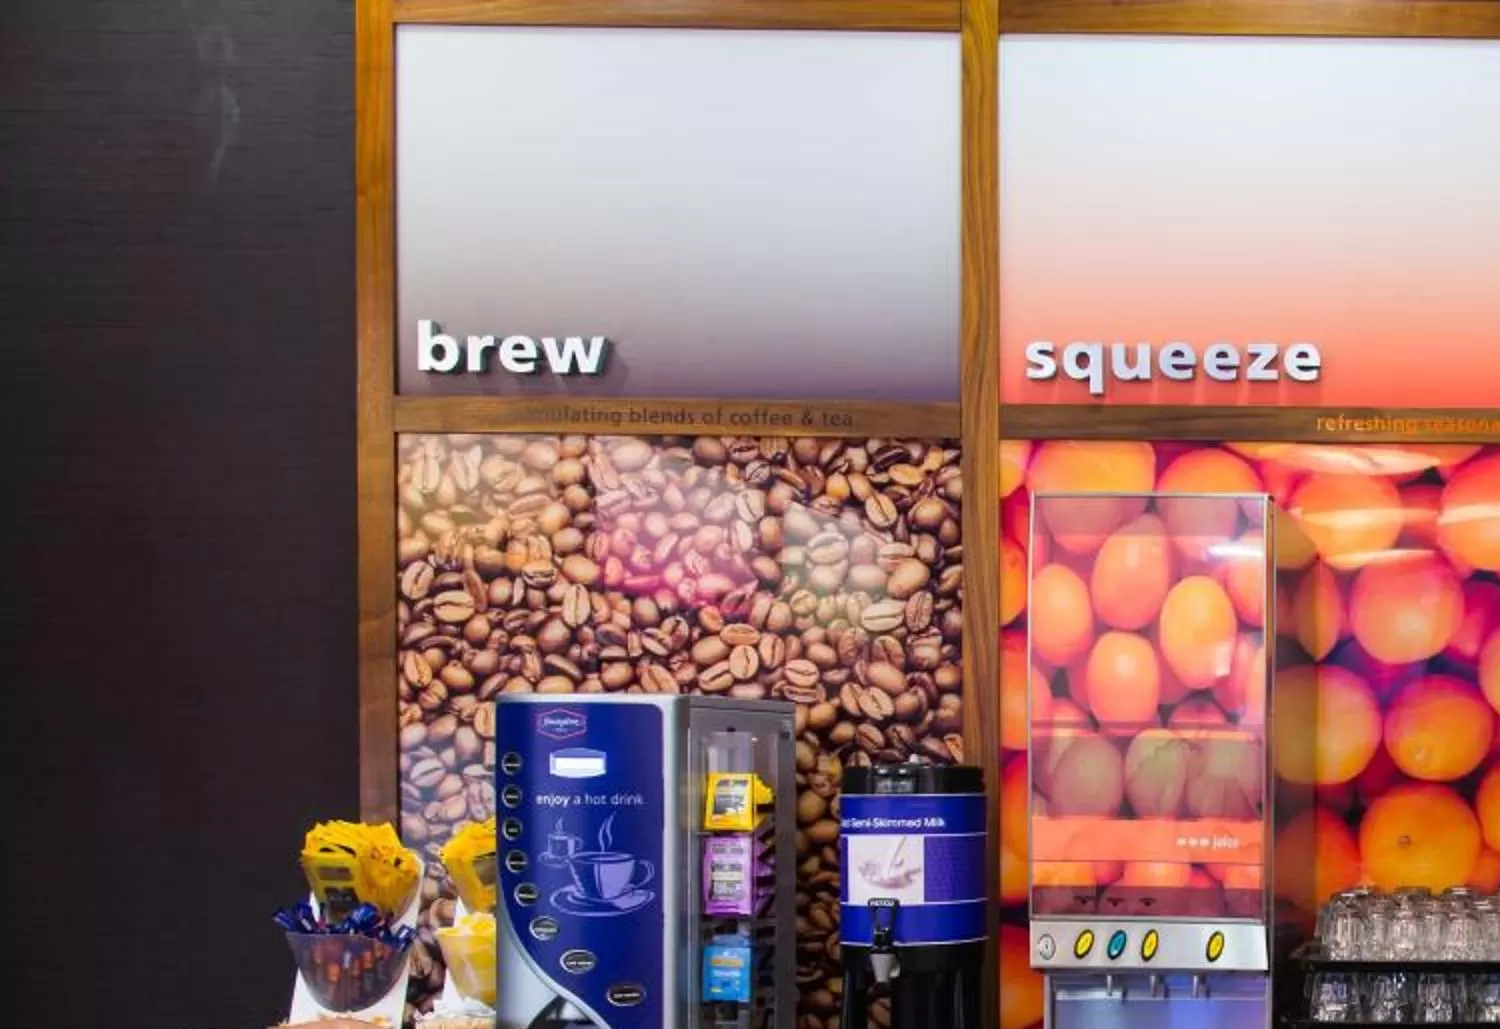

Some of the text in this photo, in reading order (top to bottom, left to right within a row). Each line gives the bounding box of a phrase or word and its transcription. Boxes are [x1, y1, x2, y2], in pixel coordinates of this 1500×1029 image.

[416, 319, 606, 375] brew
[1024, 340, 1322, 396] squeeze
[629, 406, 695, 425] blends
[702, 406, 722, 425] of
[730, 407, 793, 426] coffee
[801, 408, 815, 426] &
[821, 409, 854, 427] tea
[1316, 415, 1417, 435] refreshing
[536, 794, 644, 807] enjoy a hot drink
[1212, 835, 1240, 849] juice
